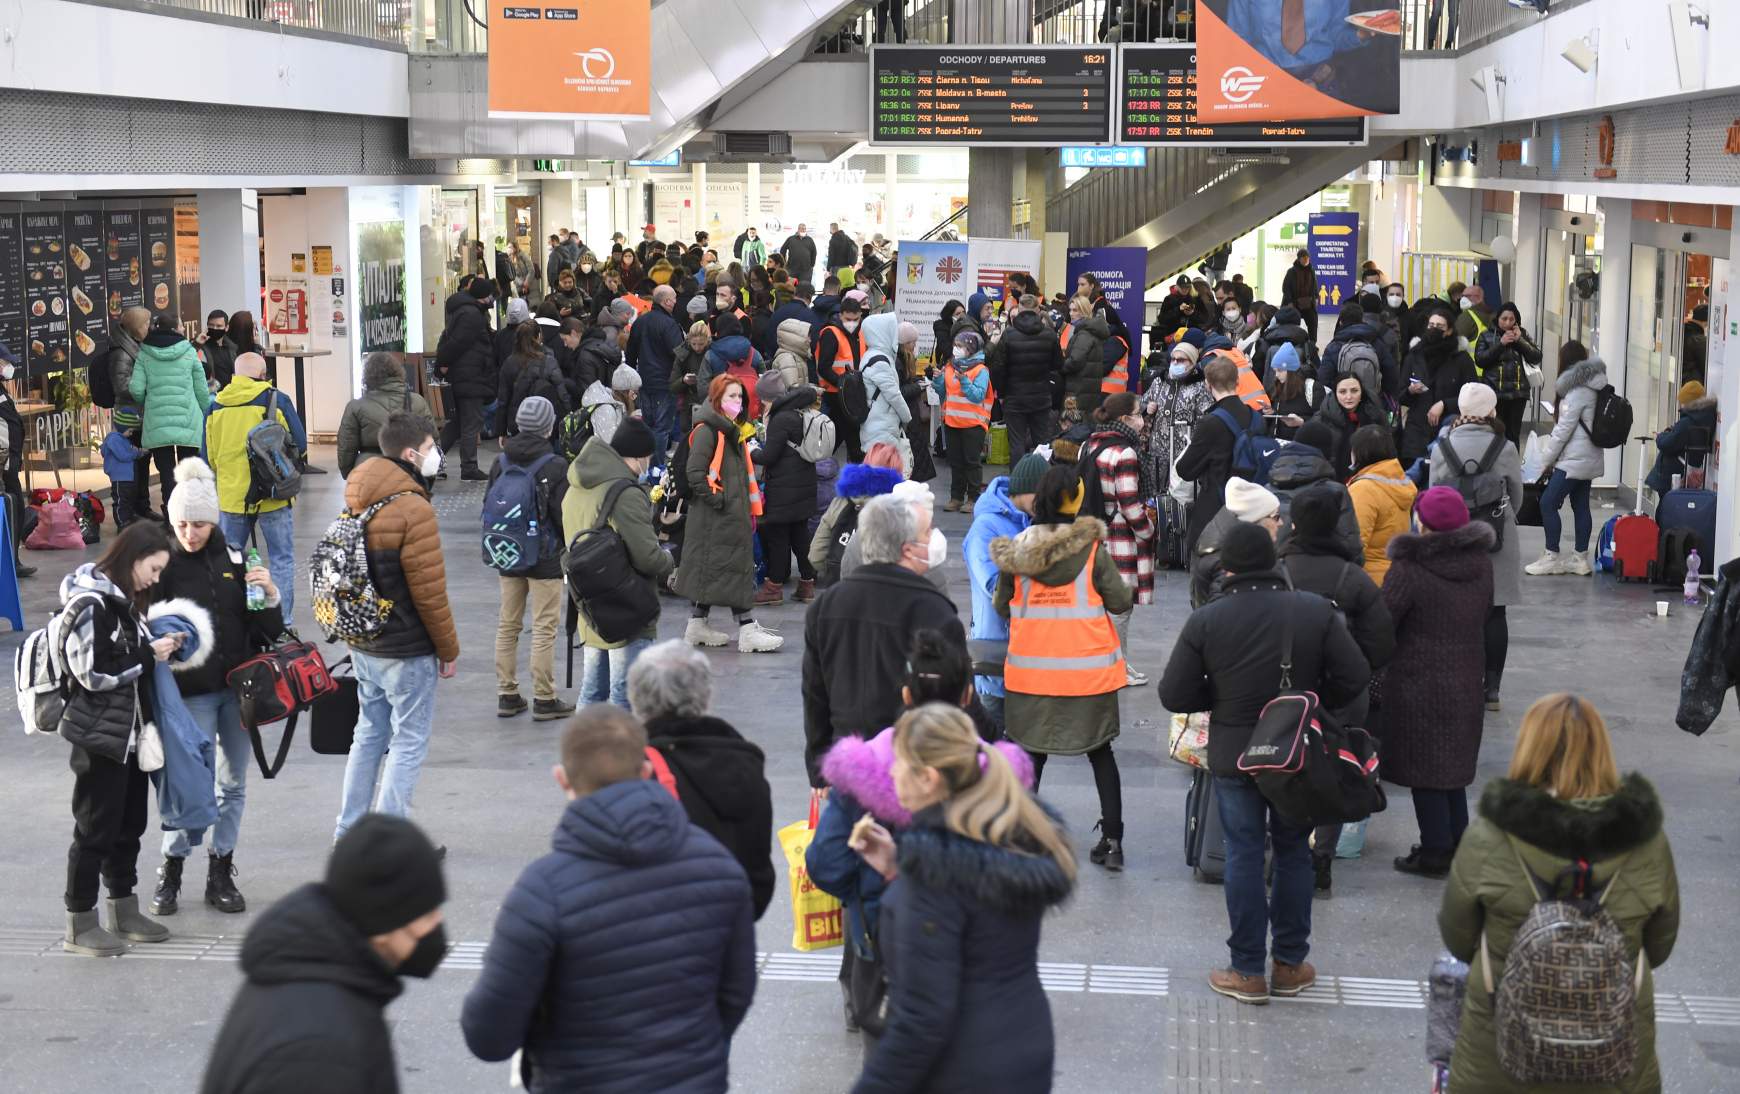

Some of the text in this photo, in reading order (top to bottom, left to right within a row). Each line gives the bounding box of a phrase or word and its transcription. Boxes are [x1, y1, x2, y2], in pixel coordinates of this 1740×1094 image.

[940, 56, 983, 64] ODCHODY
[990, 56, 1046, 64] DEPARTURES
[1083, 55, 1105, 64] 16:21
[880, 76, 898, 84] 16:27
[901, 76, 916, 84] REX
[1129, 76, 1148, 84] 17:13
[1151, 76, 1160, 84] Os
[1168, 76, 1183, 84] ZSSK
[880, 89, 898, 97] 16:32
[901, 89, 911, 97] Os
[936, 89, 965, 97] Moldava
[976, 89, 1006, 97] B-mesto
[1082, 89, 1088, 97] 3
[880, 102, 898, 110] 16:36
[901, 102, 911, 110] Os
[1082, 102, 1088, 110] 3
[880, 114, 898, 122] 17:01
[901, 114, 916, 122] REX
[936, 114, 969, 122] Humenné
[880, 127, 898, 135] 17:12
[901, 127, 915, 135] REX
[1128, 127, 1146, 135] 17:57
[1150, 127, 1160, 135] RR
[1166, 127, 1182, 135] ZSSK
[1186, 127, 1214, 135] Trenčín
[655, 184, 692, 192] BIODERM
[363, 258, 402, 306] VITAJTE
[810, 914, 841, 936] BIL
